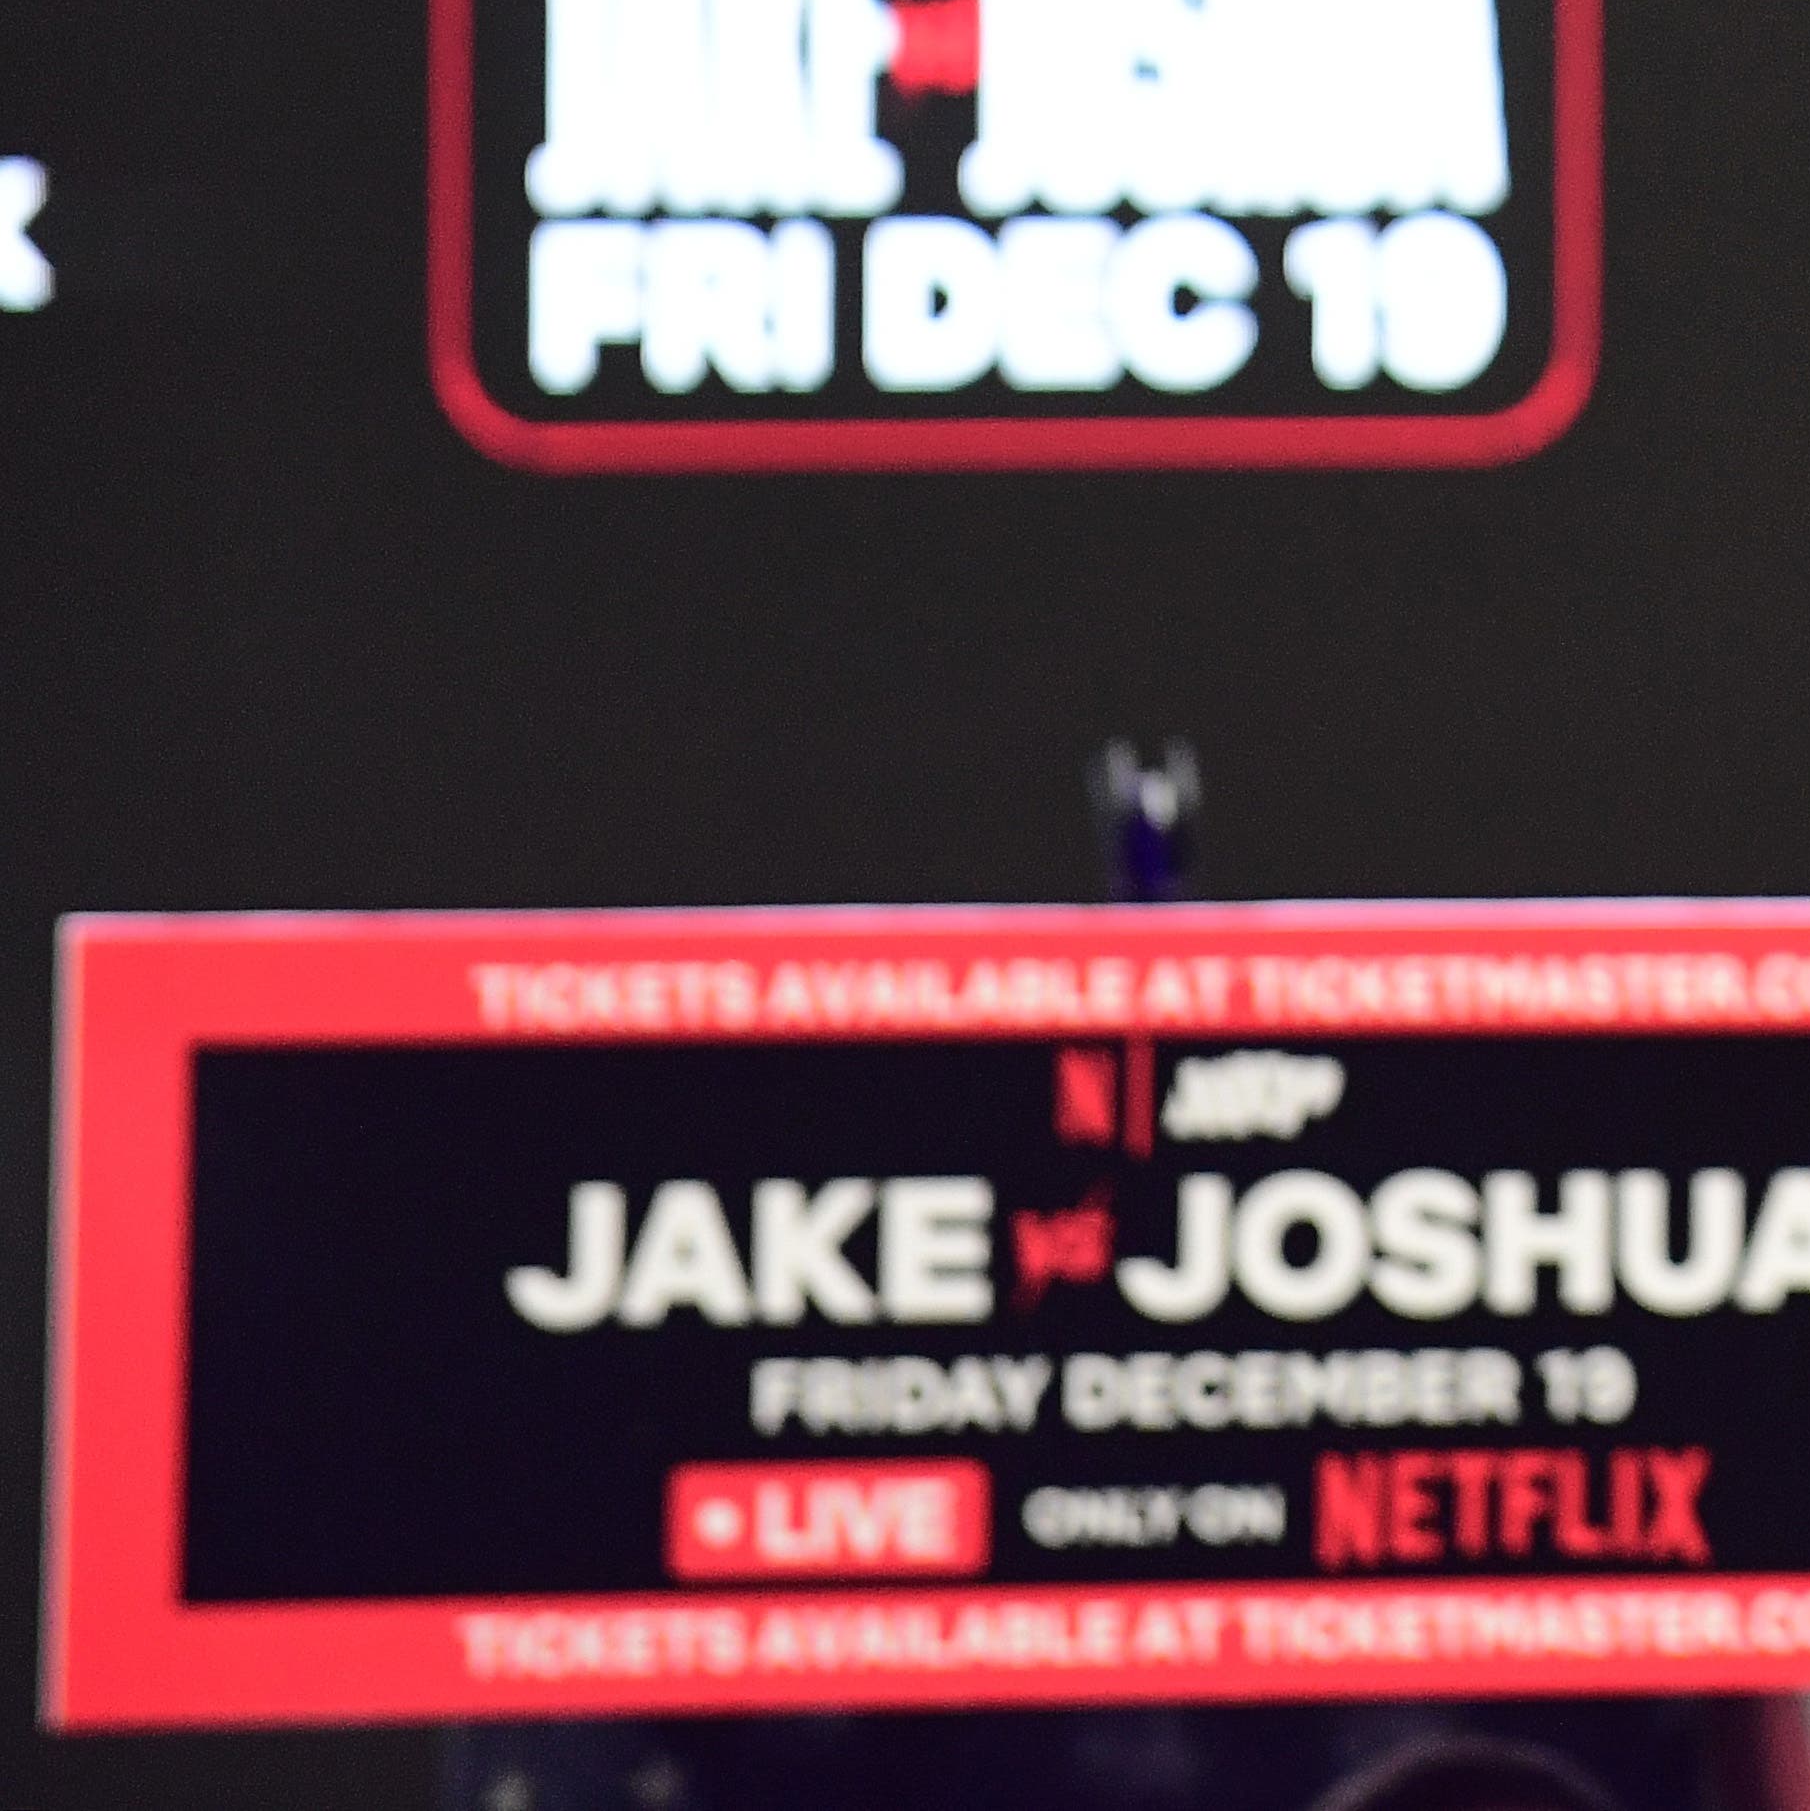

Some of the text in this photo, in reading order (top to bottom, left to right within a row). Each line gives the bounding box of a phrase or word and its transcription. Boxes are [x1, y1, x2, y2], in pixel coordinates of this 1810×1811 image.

[528, 211, 1508, 395] FRI DEC 19
[472, 960, 758, 1032] TICKETS
[763, 958, 1134, 1028] AVAILABLE
[1139, 956, 1233, 1022] AT
[506, 1176, 994, 1331] JAKE
[750, 1345, 1637, 1435] FRIDAY DECEMBER 19
[754, 1479, 954, 1563] LIVE
[1313, 1446, 1712, 1572] NETFLIX
[460, 1610, 748, 1680] TICKETS
[753, 1602, 1125, 1672] AVAILABLE
[1131, 1599, 1224, 1664] AT
